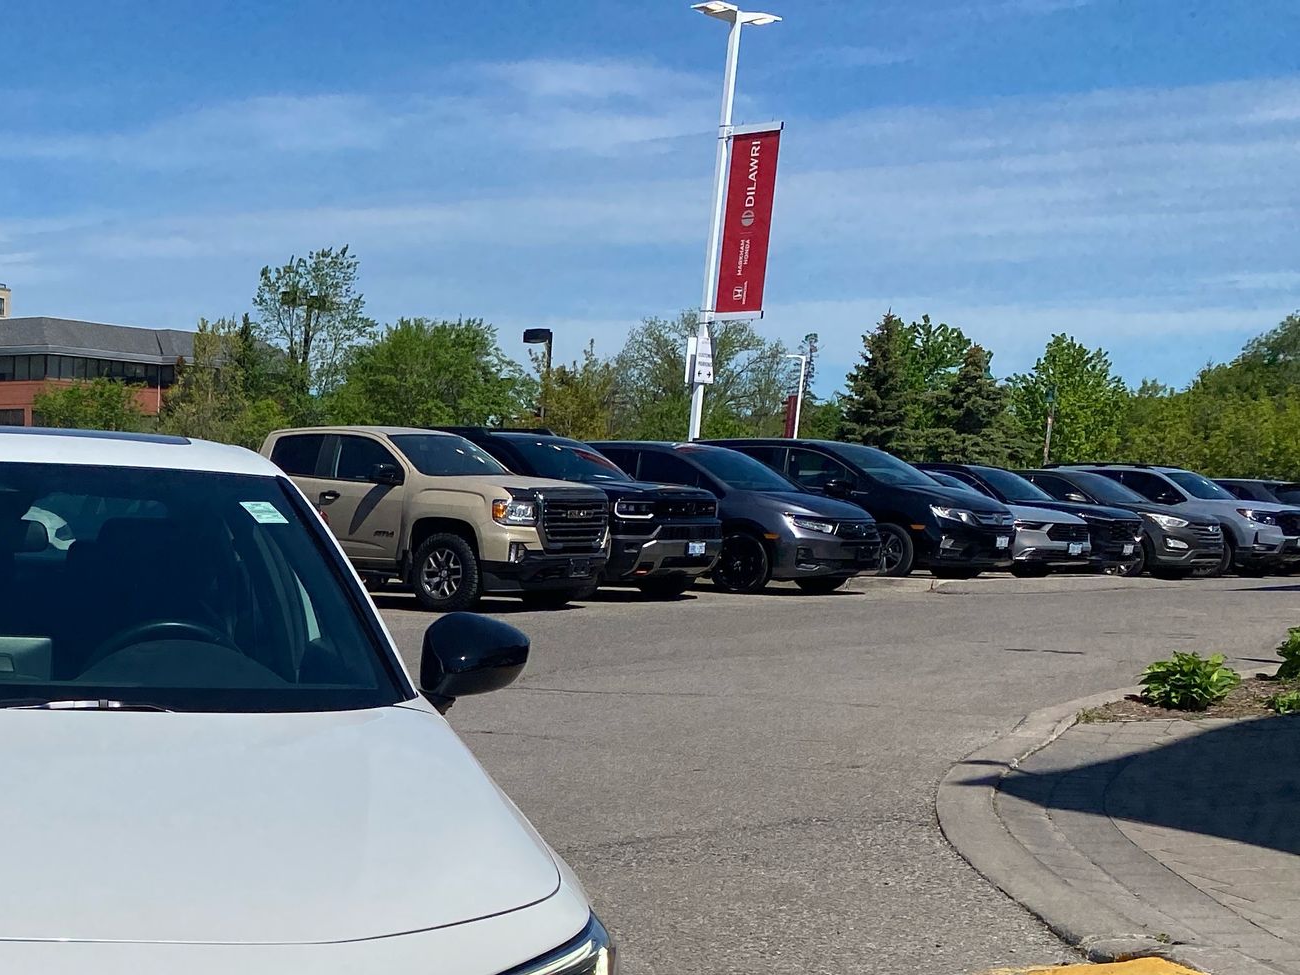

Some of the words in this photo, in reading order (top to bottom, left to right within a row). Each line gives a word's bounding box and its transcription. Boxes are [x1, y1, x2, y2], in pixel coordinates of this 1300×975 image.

[745, 140, 761, 207] DILAWRI
[736, 239, 745, 276] MARKHAM
[743, 238, 751, 265] HONDA
